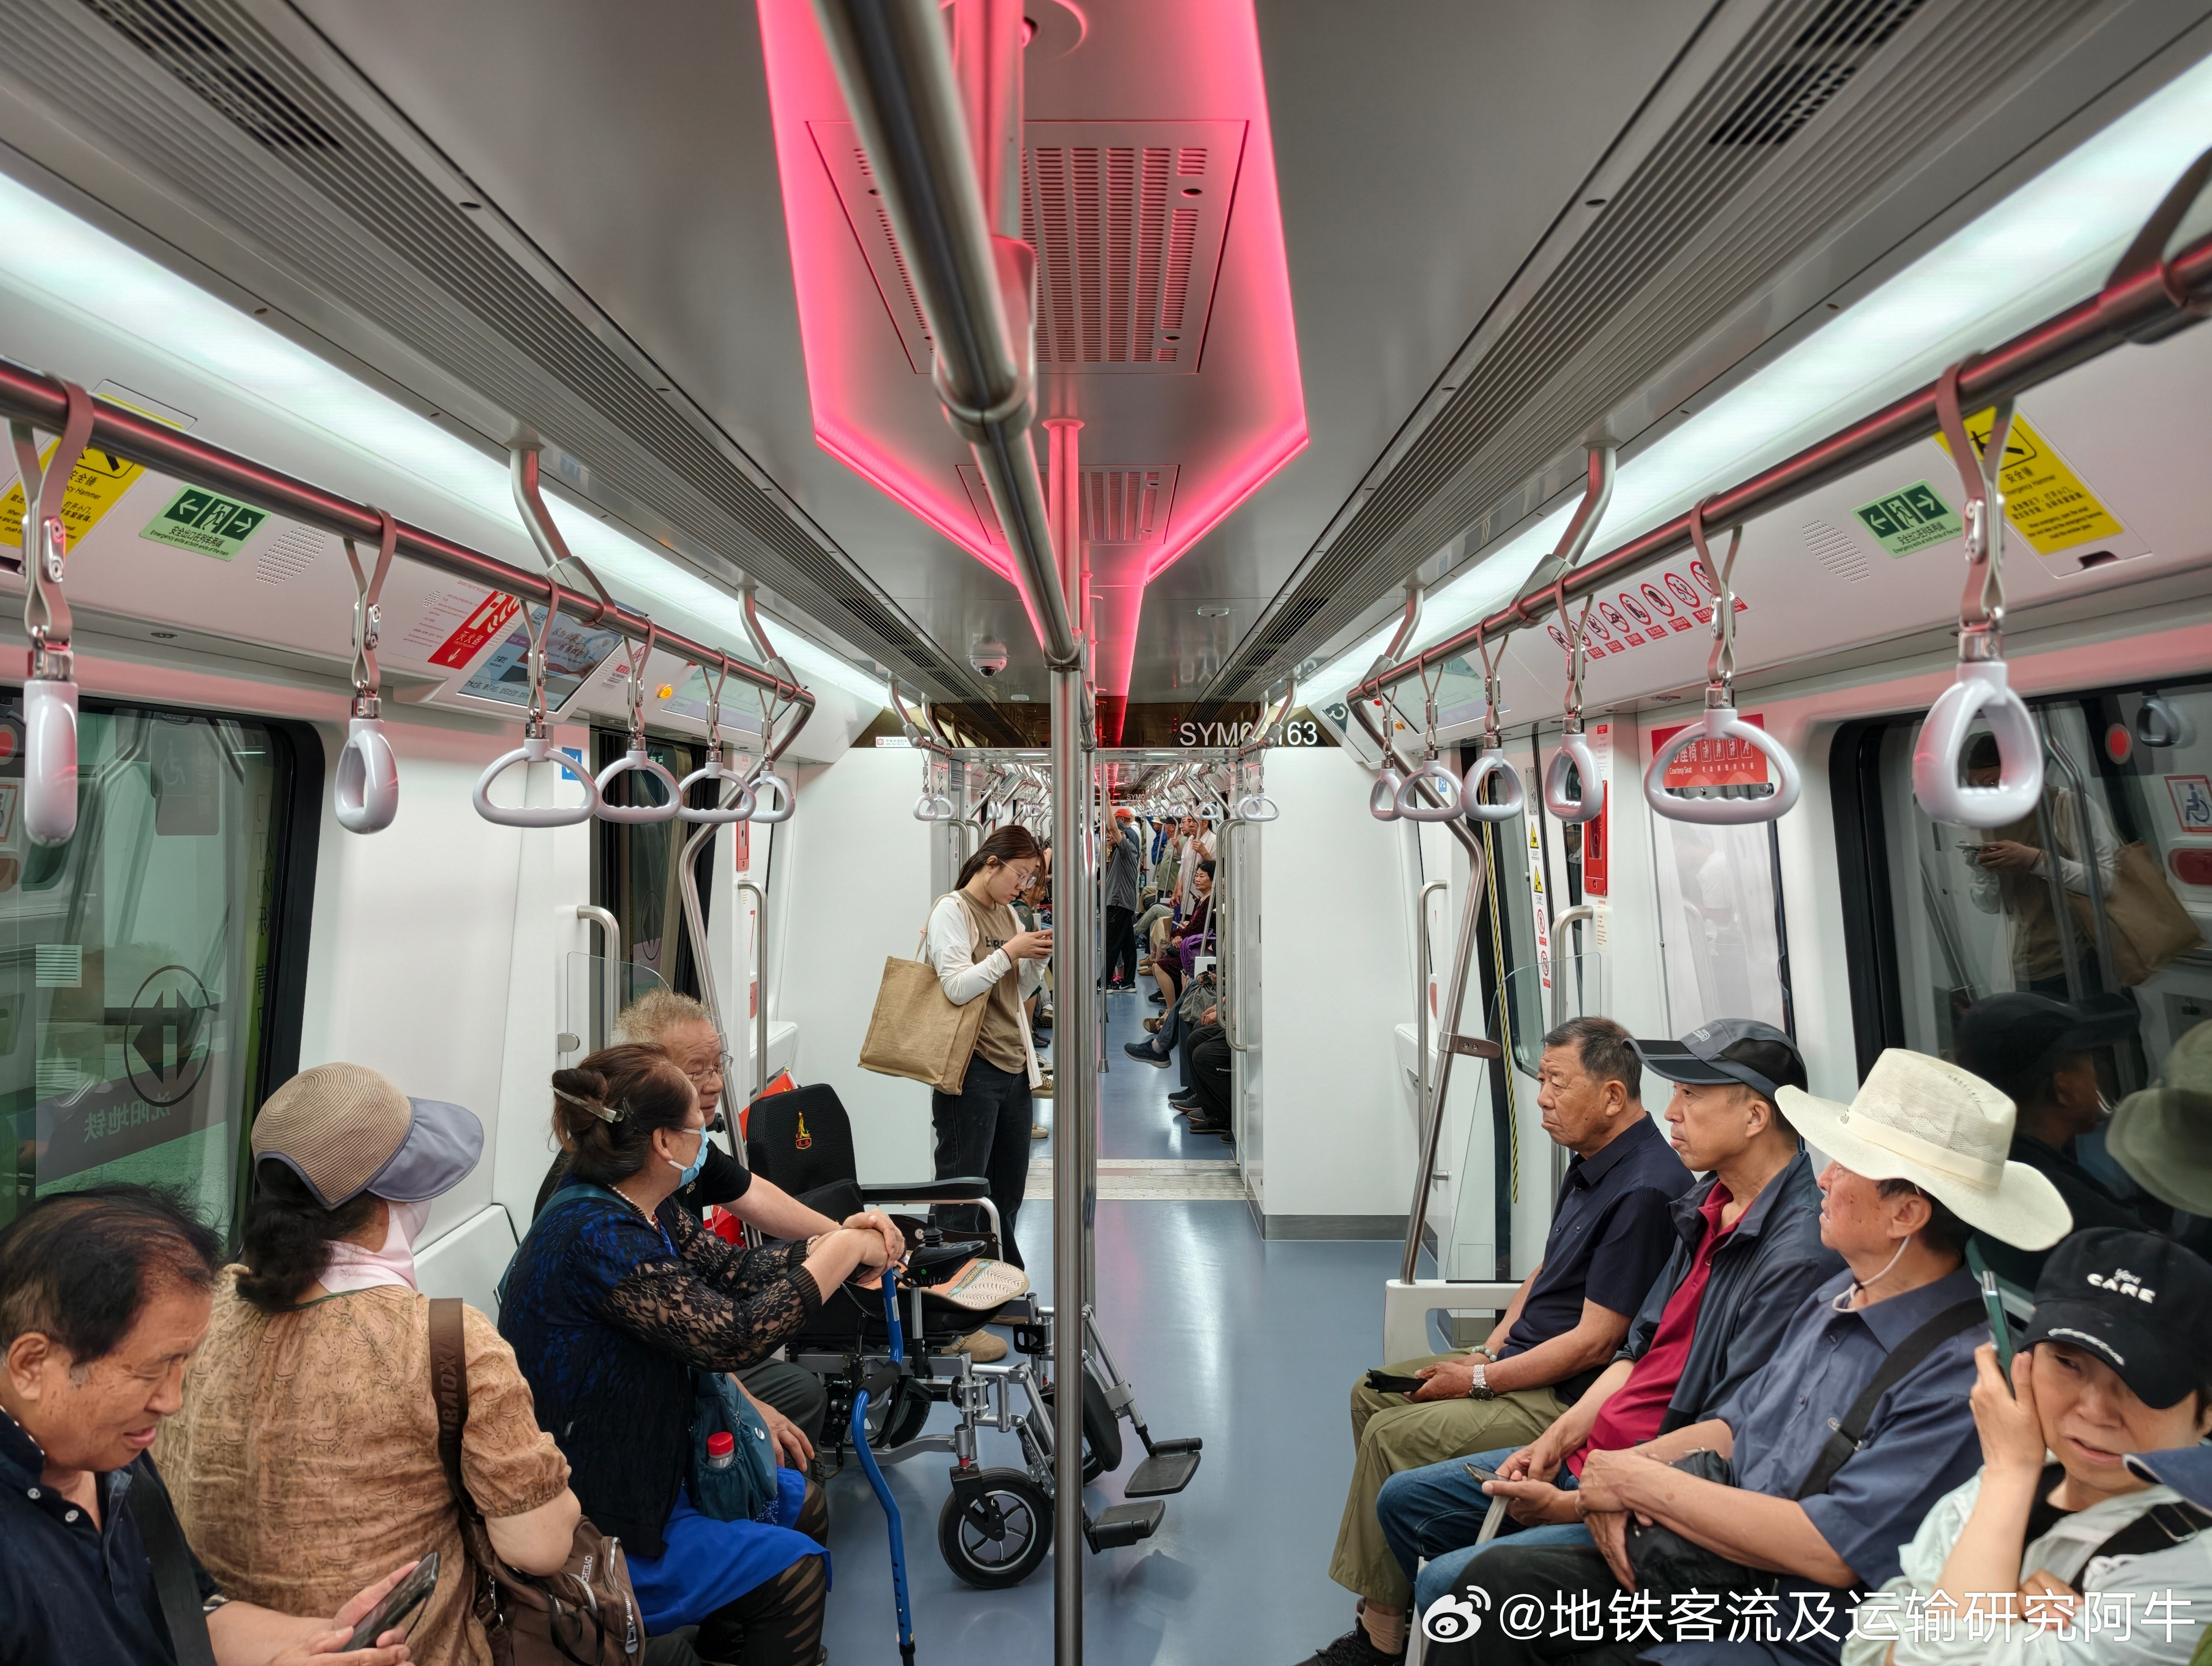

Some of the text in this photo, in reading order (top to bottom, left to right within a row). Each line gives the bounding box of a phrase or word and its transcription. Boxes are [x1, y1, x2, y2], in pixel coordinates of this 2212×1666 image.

[75, 488, 101, 499] Hammer
[150, 530, 175, 542] Emergency
[1669, 767, 1684, 776] Courtesy
[2087, 1273, 2156, 1303] CARE
